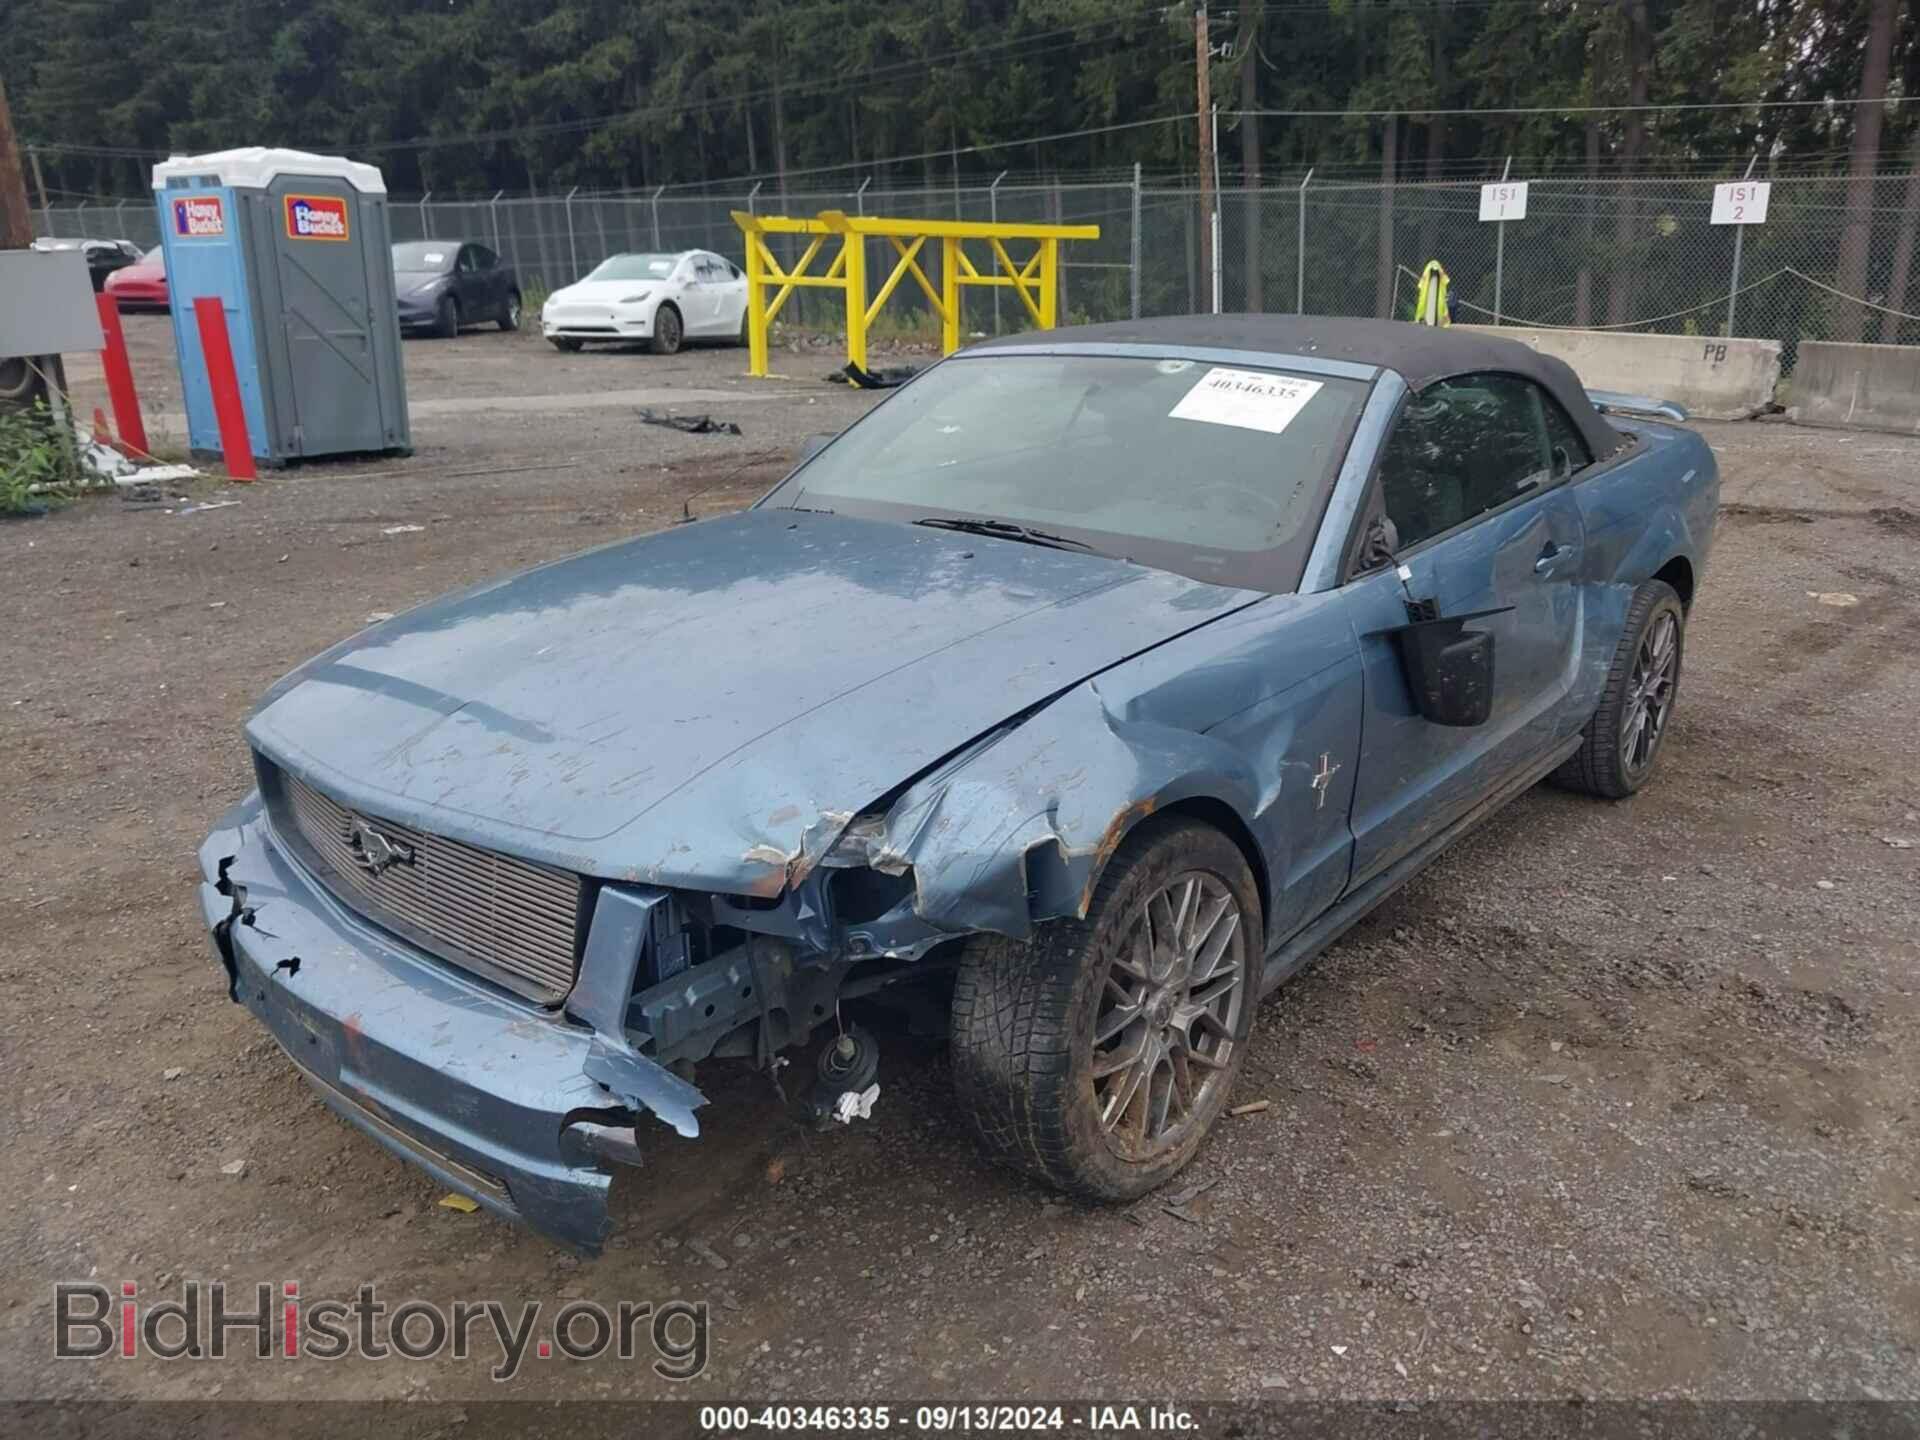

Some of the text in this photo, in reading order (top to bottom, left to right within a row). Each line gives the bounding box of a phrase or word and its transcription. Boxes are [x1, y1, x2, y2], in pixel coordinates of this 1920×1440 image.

[1733, 206, 1744, 220] 2
[1703, 344, 1727, 362] PB
[1208, 378, 1299, 399] 40346335
